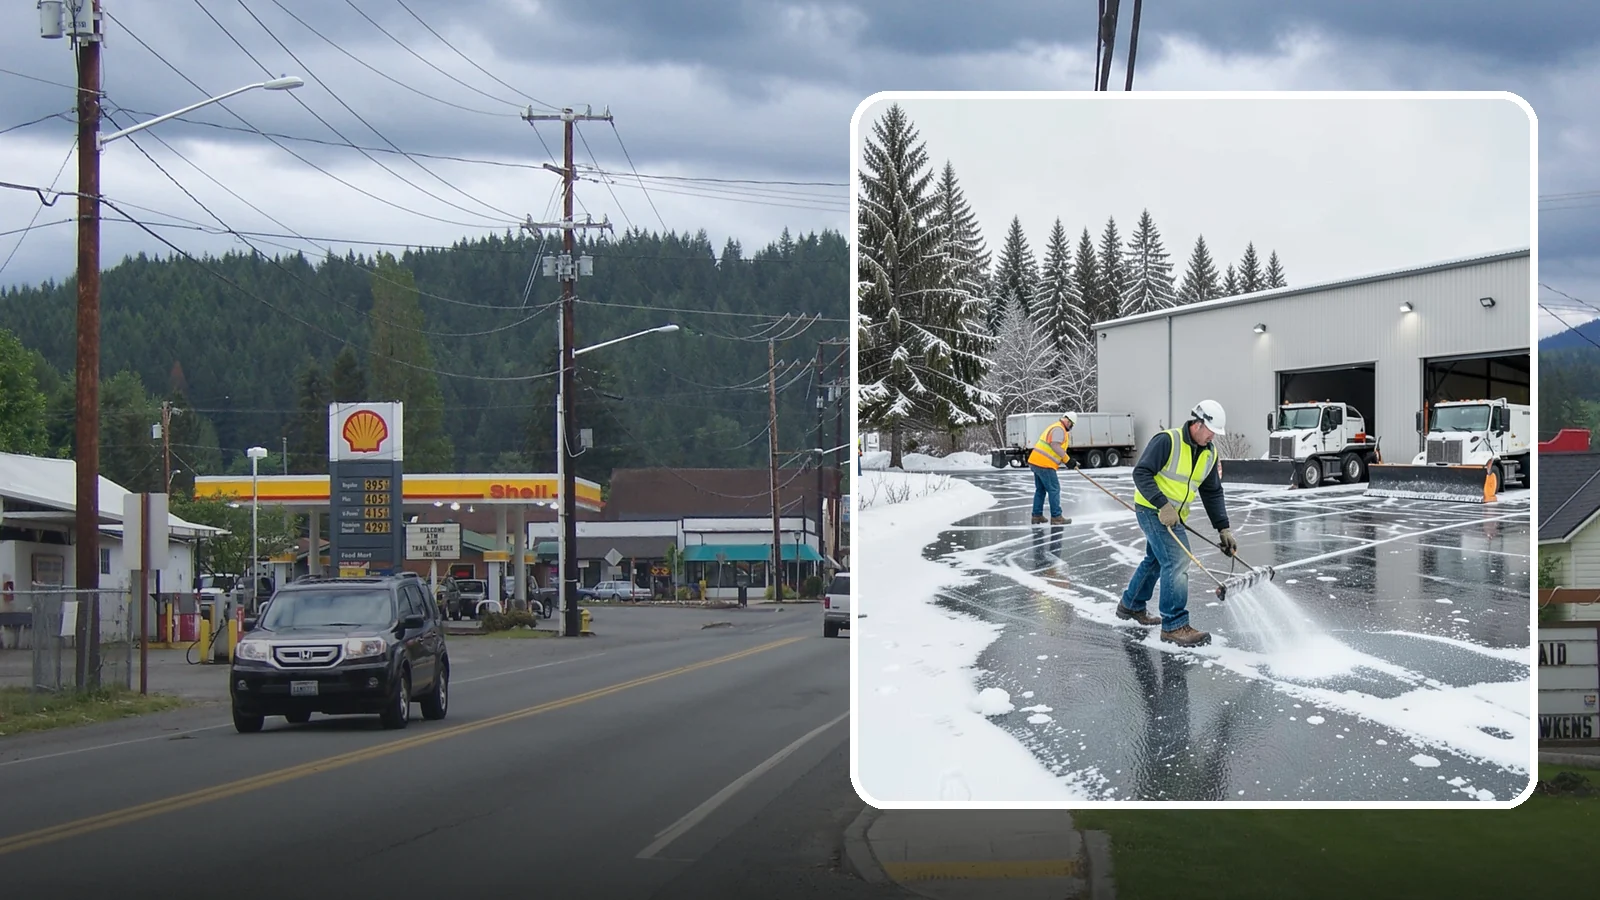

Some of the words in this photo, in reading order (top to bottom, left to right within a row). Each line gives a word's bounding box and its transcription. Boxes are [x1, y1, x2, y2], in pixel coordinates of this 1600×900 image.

[365, 480, 384, 490] 395
[490, 484, 547, 499] Shell
[365, 494, 384, 504] 405
[365, 508, 384, 518] 415
[365, 522, 384, 532] 429
[1538, 642, 1567, 665] AID
[1538, 715, 1593, 739] WKENS
